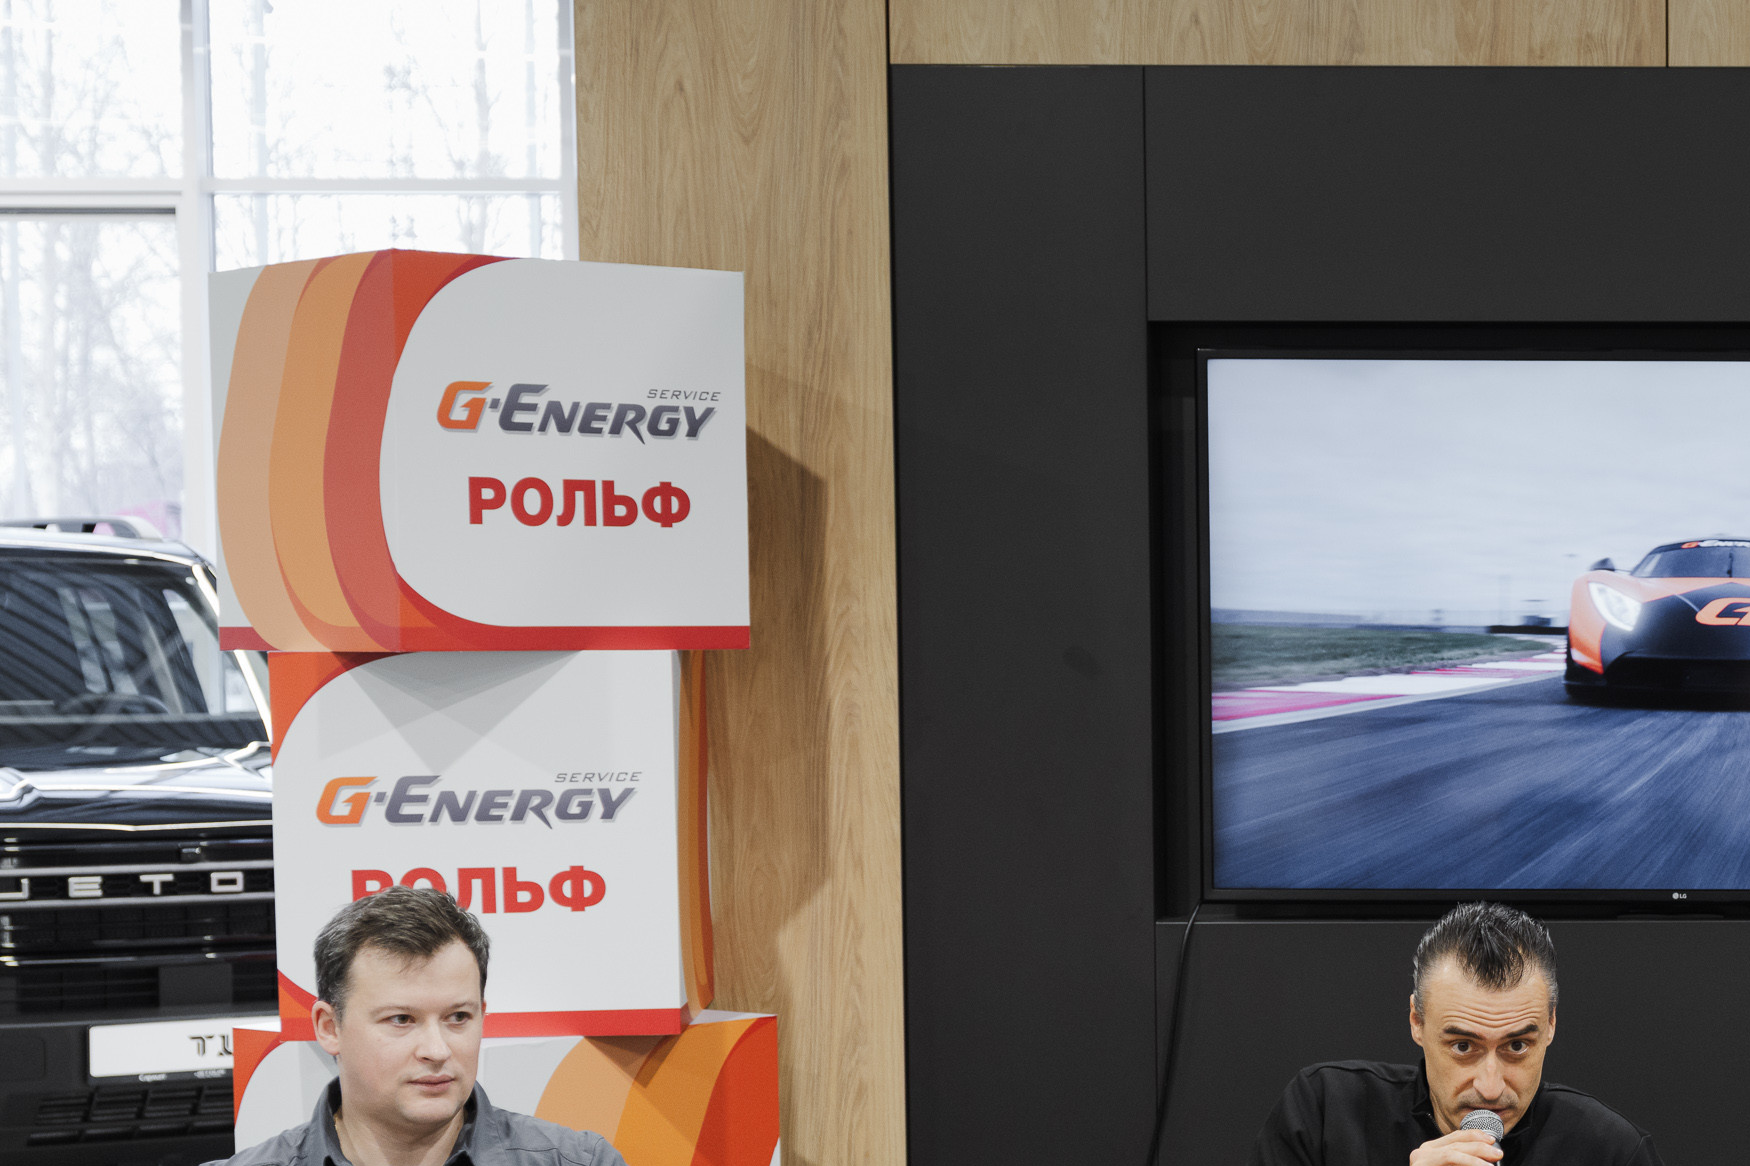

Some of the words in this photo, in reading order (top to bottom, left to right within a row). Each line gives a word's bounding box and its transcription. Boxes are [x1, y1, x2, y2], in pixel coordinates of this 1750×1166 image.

[646, 388, 721, 402] SERVICE
[468, 476, 691, 528] РОЛЬФ
[554, 771, 643, 783] SERVICE
